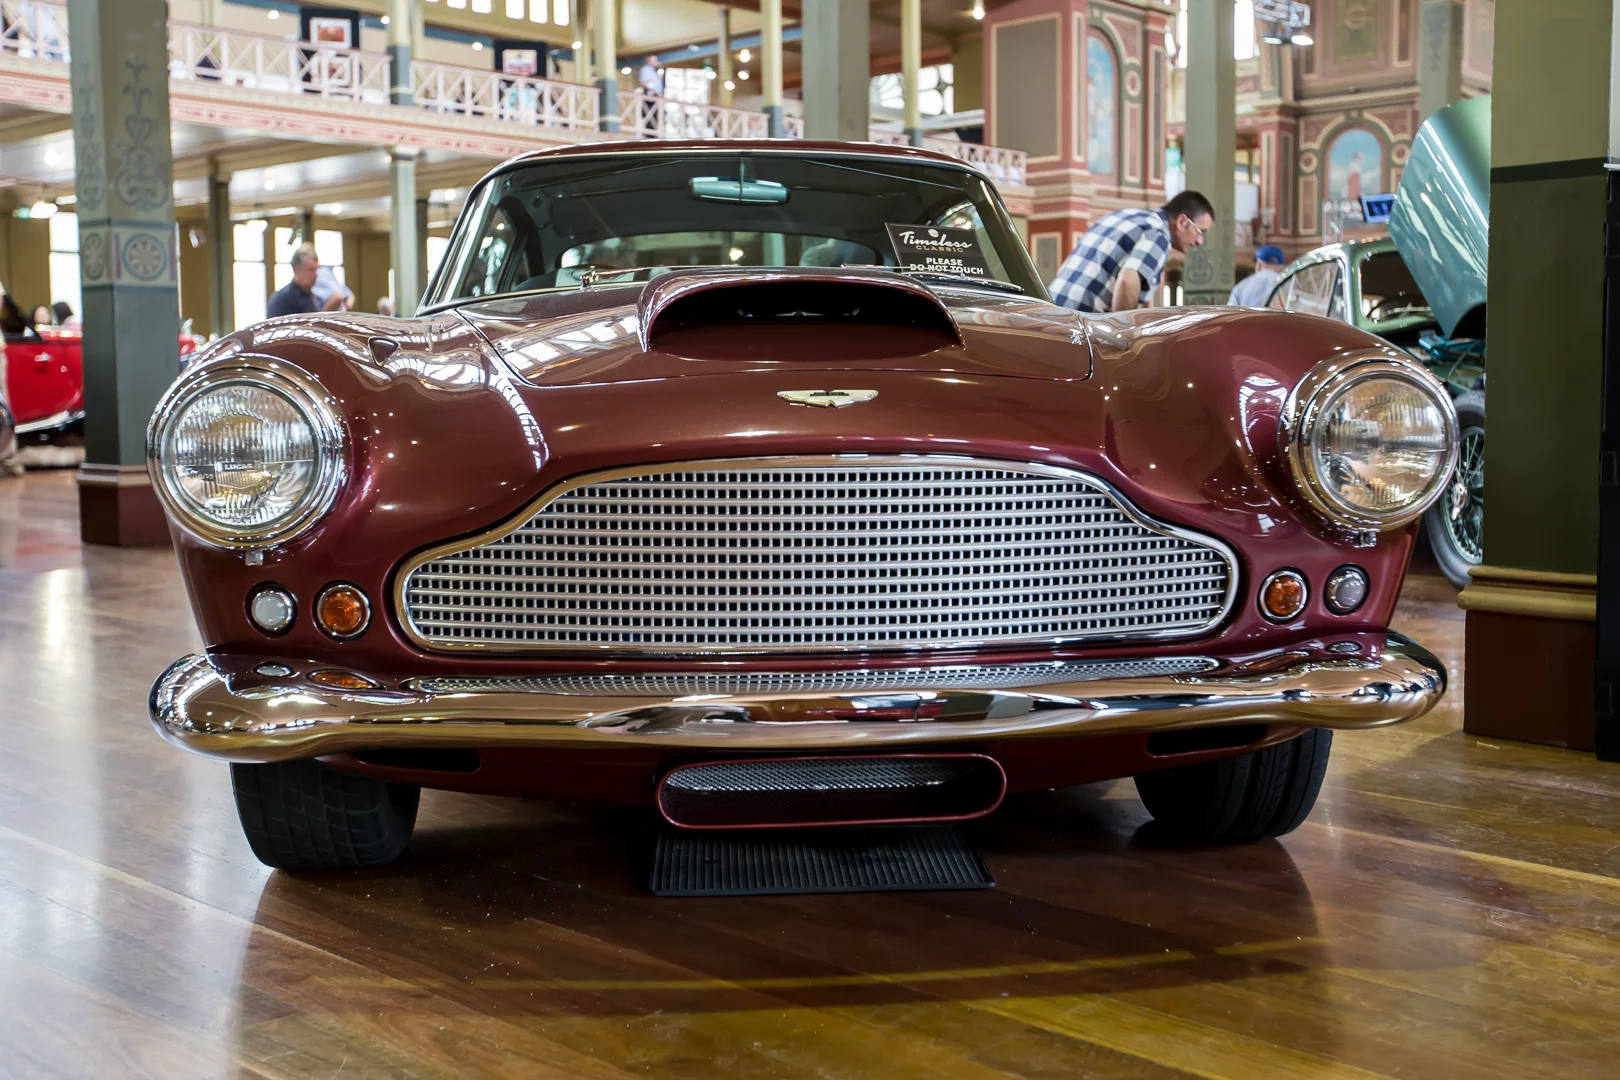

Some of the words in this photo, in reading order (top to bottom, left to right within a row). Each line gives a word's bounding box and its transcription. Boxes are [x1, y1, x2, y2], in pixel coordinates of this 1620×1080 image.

[899, 231, 972, 248] Timeless
[916, 245, 964, 253] CLASSIC
[926, 257, 963, 266] PLEASE
[928, 264, 948, 272] NOT
[950, 265, 984, 275] TOUCH
